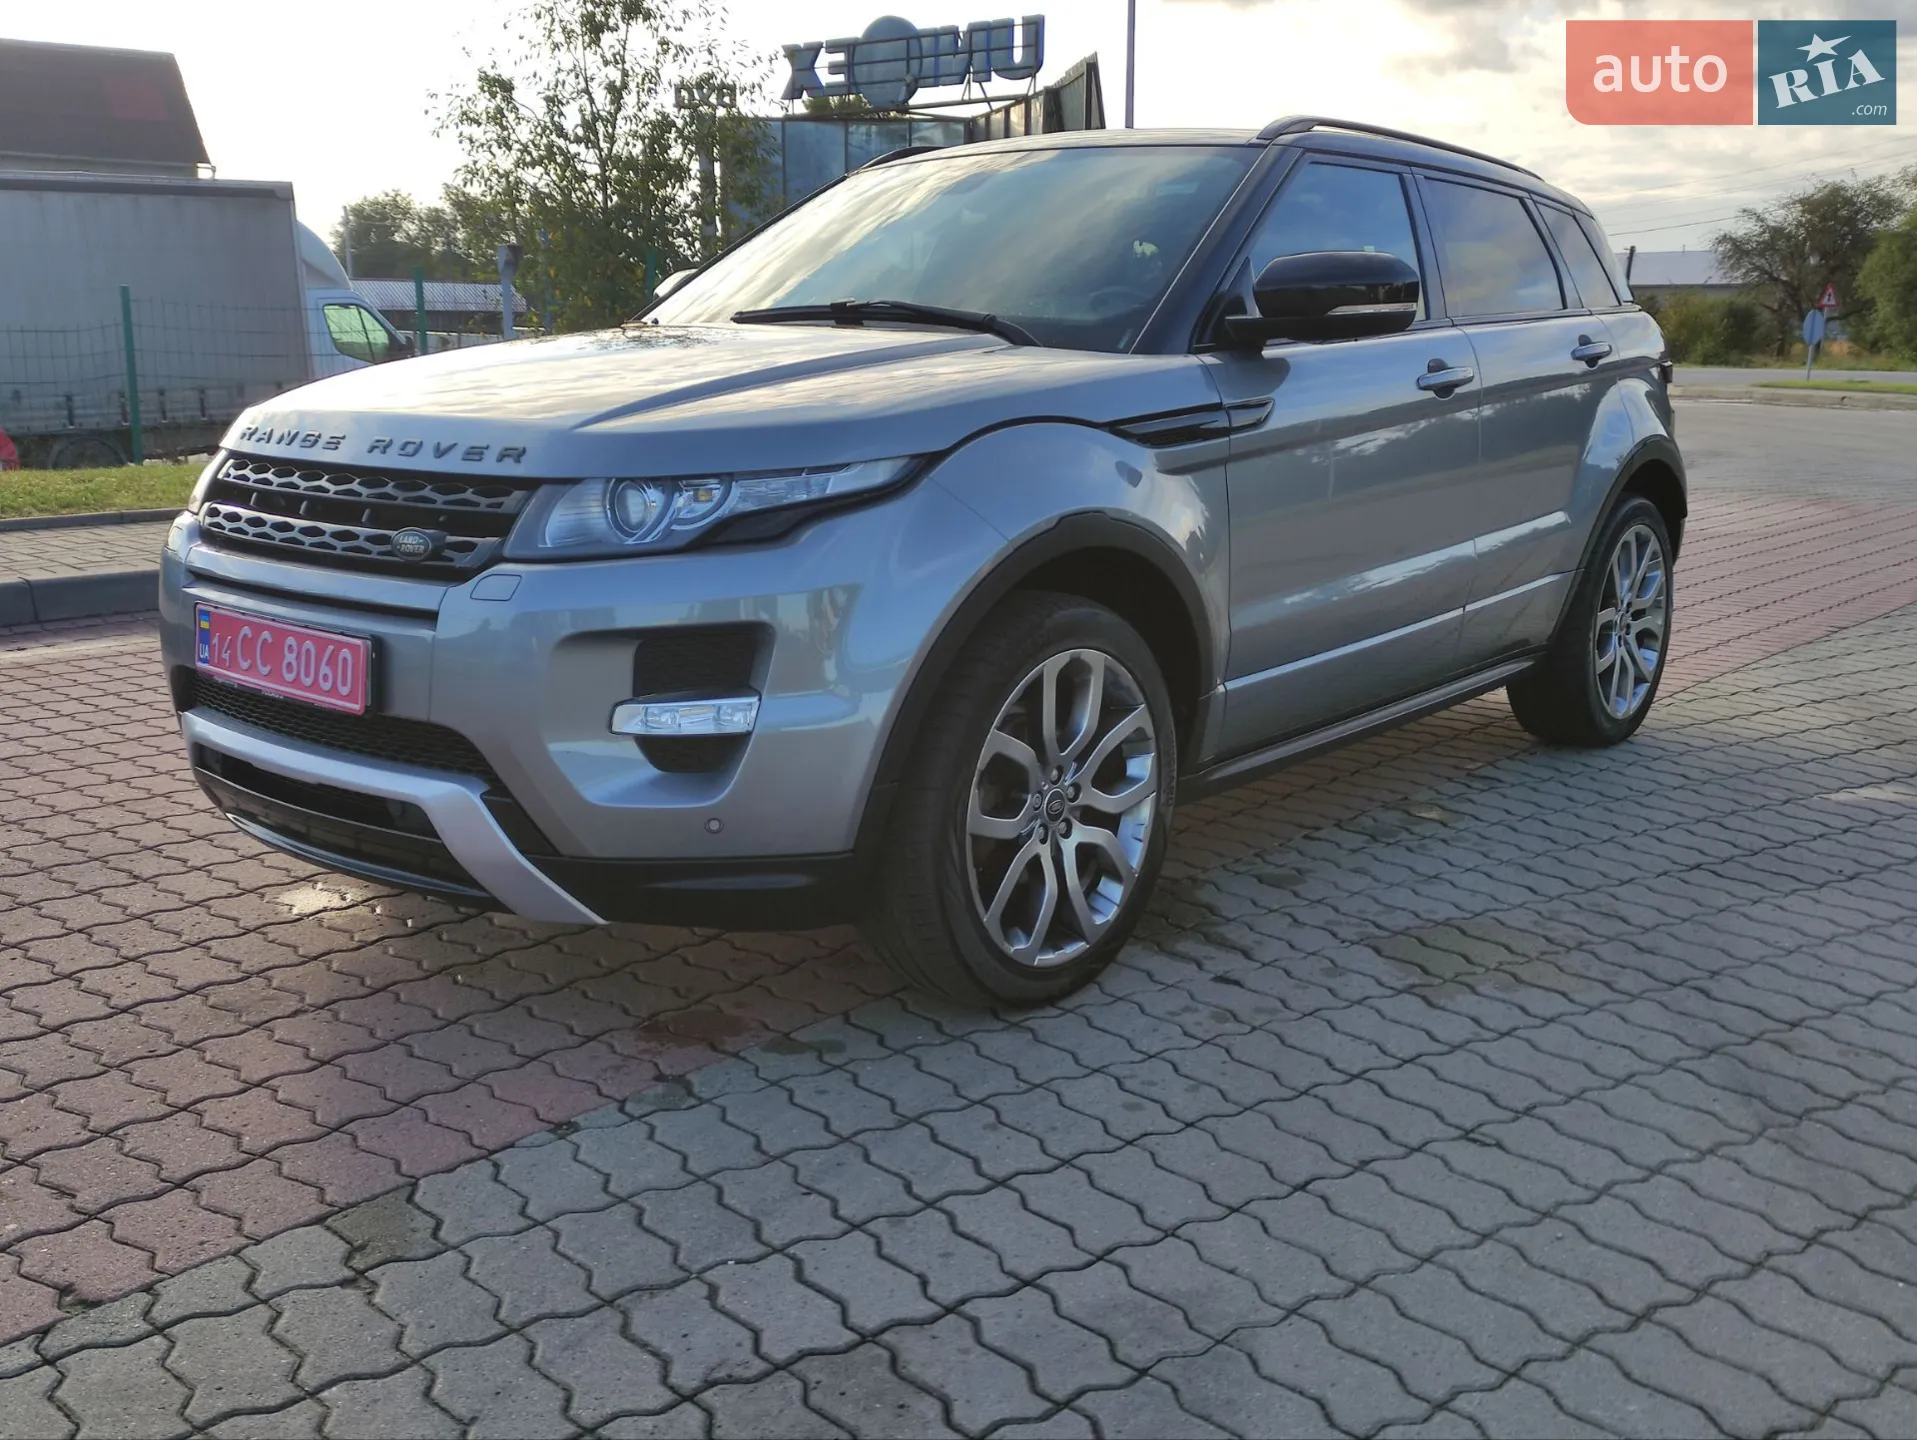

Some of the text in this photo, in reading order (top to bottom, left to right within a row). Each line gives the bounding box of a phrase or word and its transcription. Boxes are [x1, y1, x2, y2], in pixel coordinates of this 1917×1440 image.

[239, 425, 527, 464] RANGE ROVER
[200, 643, 210, 660] UA
[282, 636, 353, 696] 8060
